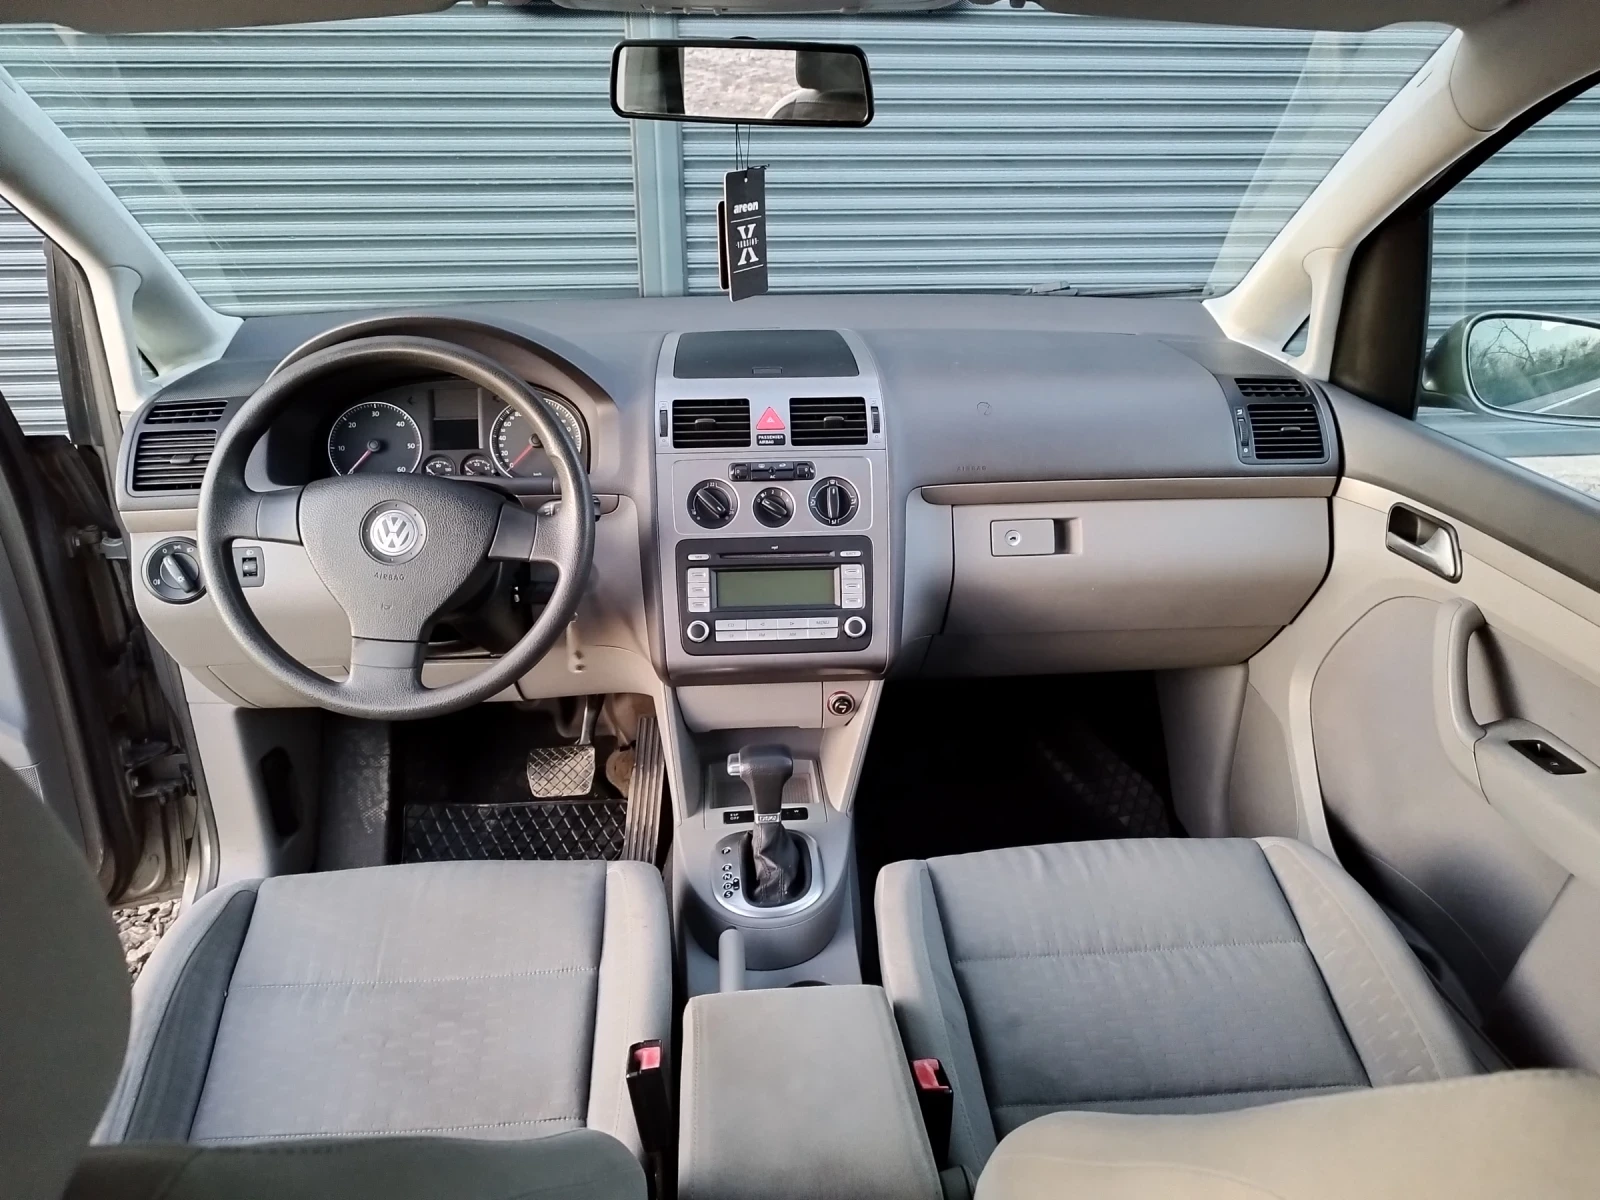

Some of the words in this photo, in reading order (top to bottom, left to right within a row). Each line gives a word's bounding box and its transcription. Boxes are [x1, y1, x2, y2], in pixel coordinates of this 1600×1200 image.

[733, 201, 759, 214] areon
[396, 420, 405, 428] 40
[374, 572, 405, 581] AIRBAG
